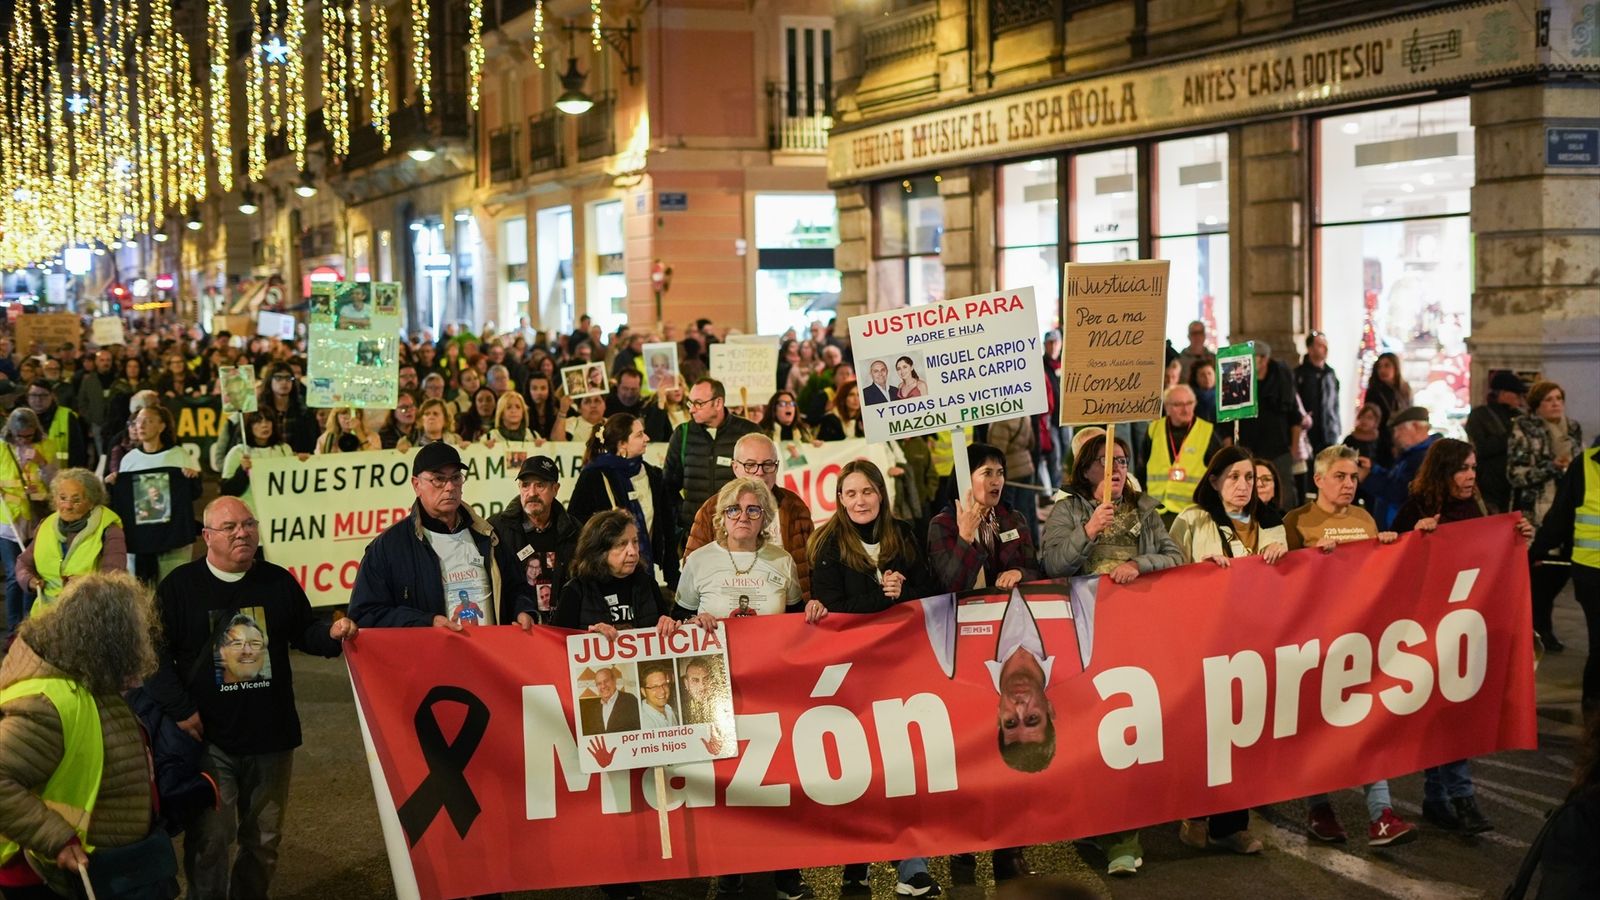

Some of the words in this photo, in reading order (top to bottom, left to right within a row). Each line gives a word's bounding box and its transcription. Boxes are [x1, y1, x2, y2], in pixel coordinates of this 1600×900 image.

[1182, 70, 1237, 107] ANTES
[911, 110, 999, 158] MUSICAL
[965, 294, 1025, 319] PARA
[1076, 306, 1103, 327] Per
[1107, 313, 1119, 324] a
[1122, 311, 1147, 323] ma
[906, 330, 945, 345] PADRE
[948, 328, 955, 337] E
[959, 323, 985, 336] HIJA
[926, 350, 974, 369] MIGUEL
[977, 340, 1025, 360] CARPIO
[1028, 337, 1037, 350] Y
[941, 366, 976, 384] SARA
[979, 357, 1027, 377] CARPIO
[876, 407, 885, 418] Y
[889, 399, 935, 417] TODAS
[939, 393, 965, 408] LAS
[968, 381, 1032, 402] VICTIMAS
[889, 412, 947, 434] MAZÓN
[960, 398, 1024, 421] PRISIÓN
[270, 514, 326, 543] HAN
[574, 627, 722, 664] JUSTICIA
[220, 683, 239, 692] José
[240, 681, 270, 690] Vicente
[1092, 665, 1164, 770] a
[1203, 568, 1488, 787] presó
[621, 734, 639, 744] por
[642, 730, 655, 740] mi
[658, 726, 694, 738] marido
[631, 748, 639, 757] y
[640, 744, 660, 754] mis
[662, 741, 687, 753] hijos
